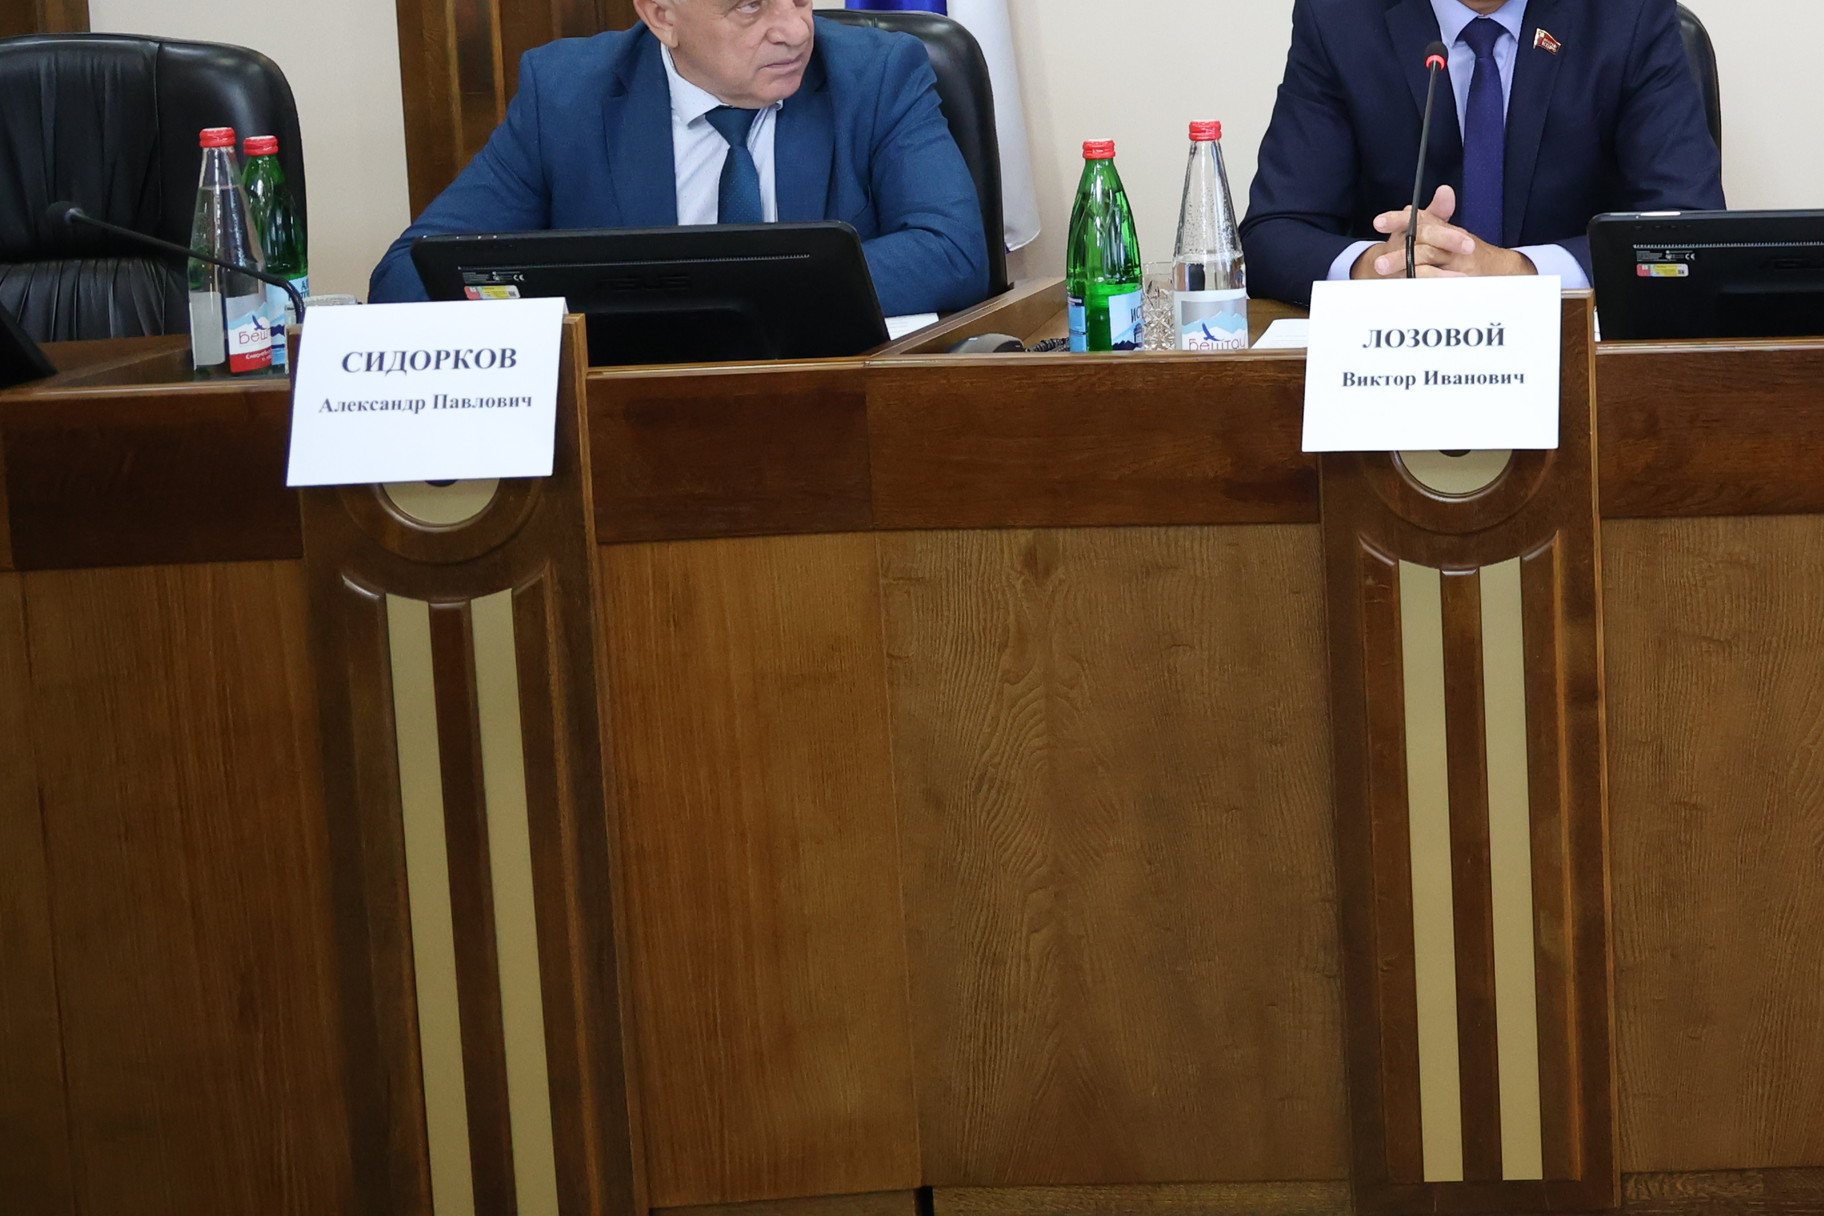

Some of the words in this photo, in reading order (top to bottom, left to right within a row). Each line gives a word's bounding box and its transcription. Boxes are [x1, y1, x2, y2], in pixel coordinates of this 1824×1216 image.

[1362, 322, 1505, 348] ЛОЗОВОЙ
[341, 348, 518, 376] СИДОРКОВ
[1342, 371, 1417, 390] Виктор
[1423, 370, 1525, 386] Иванович
[319, 397, 426, 415] Александр
[432, 393, 533, 410] Павлович
